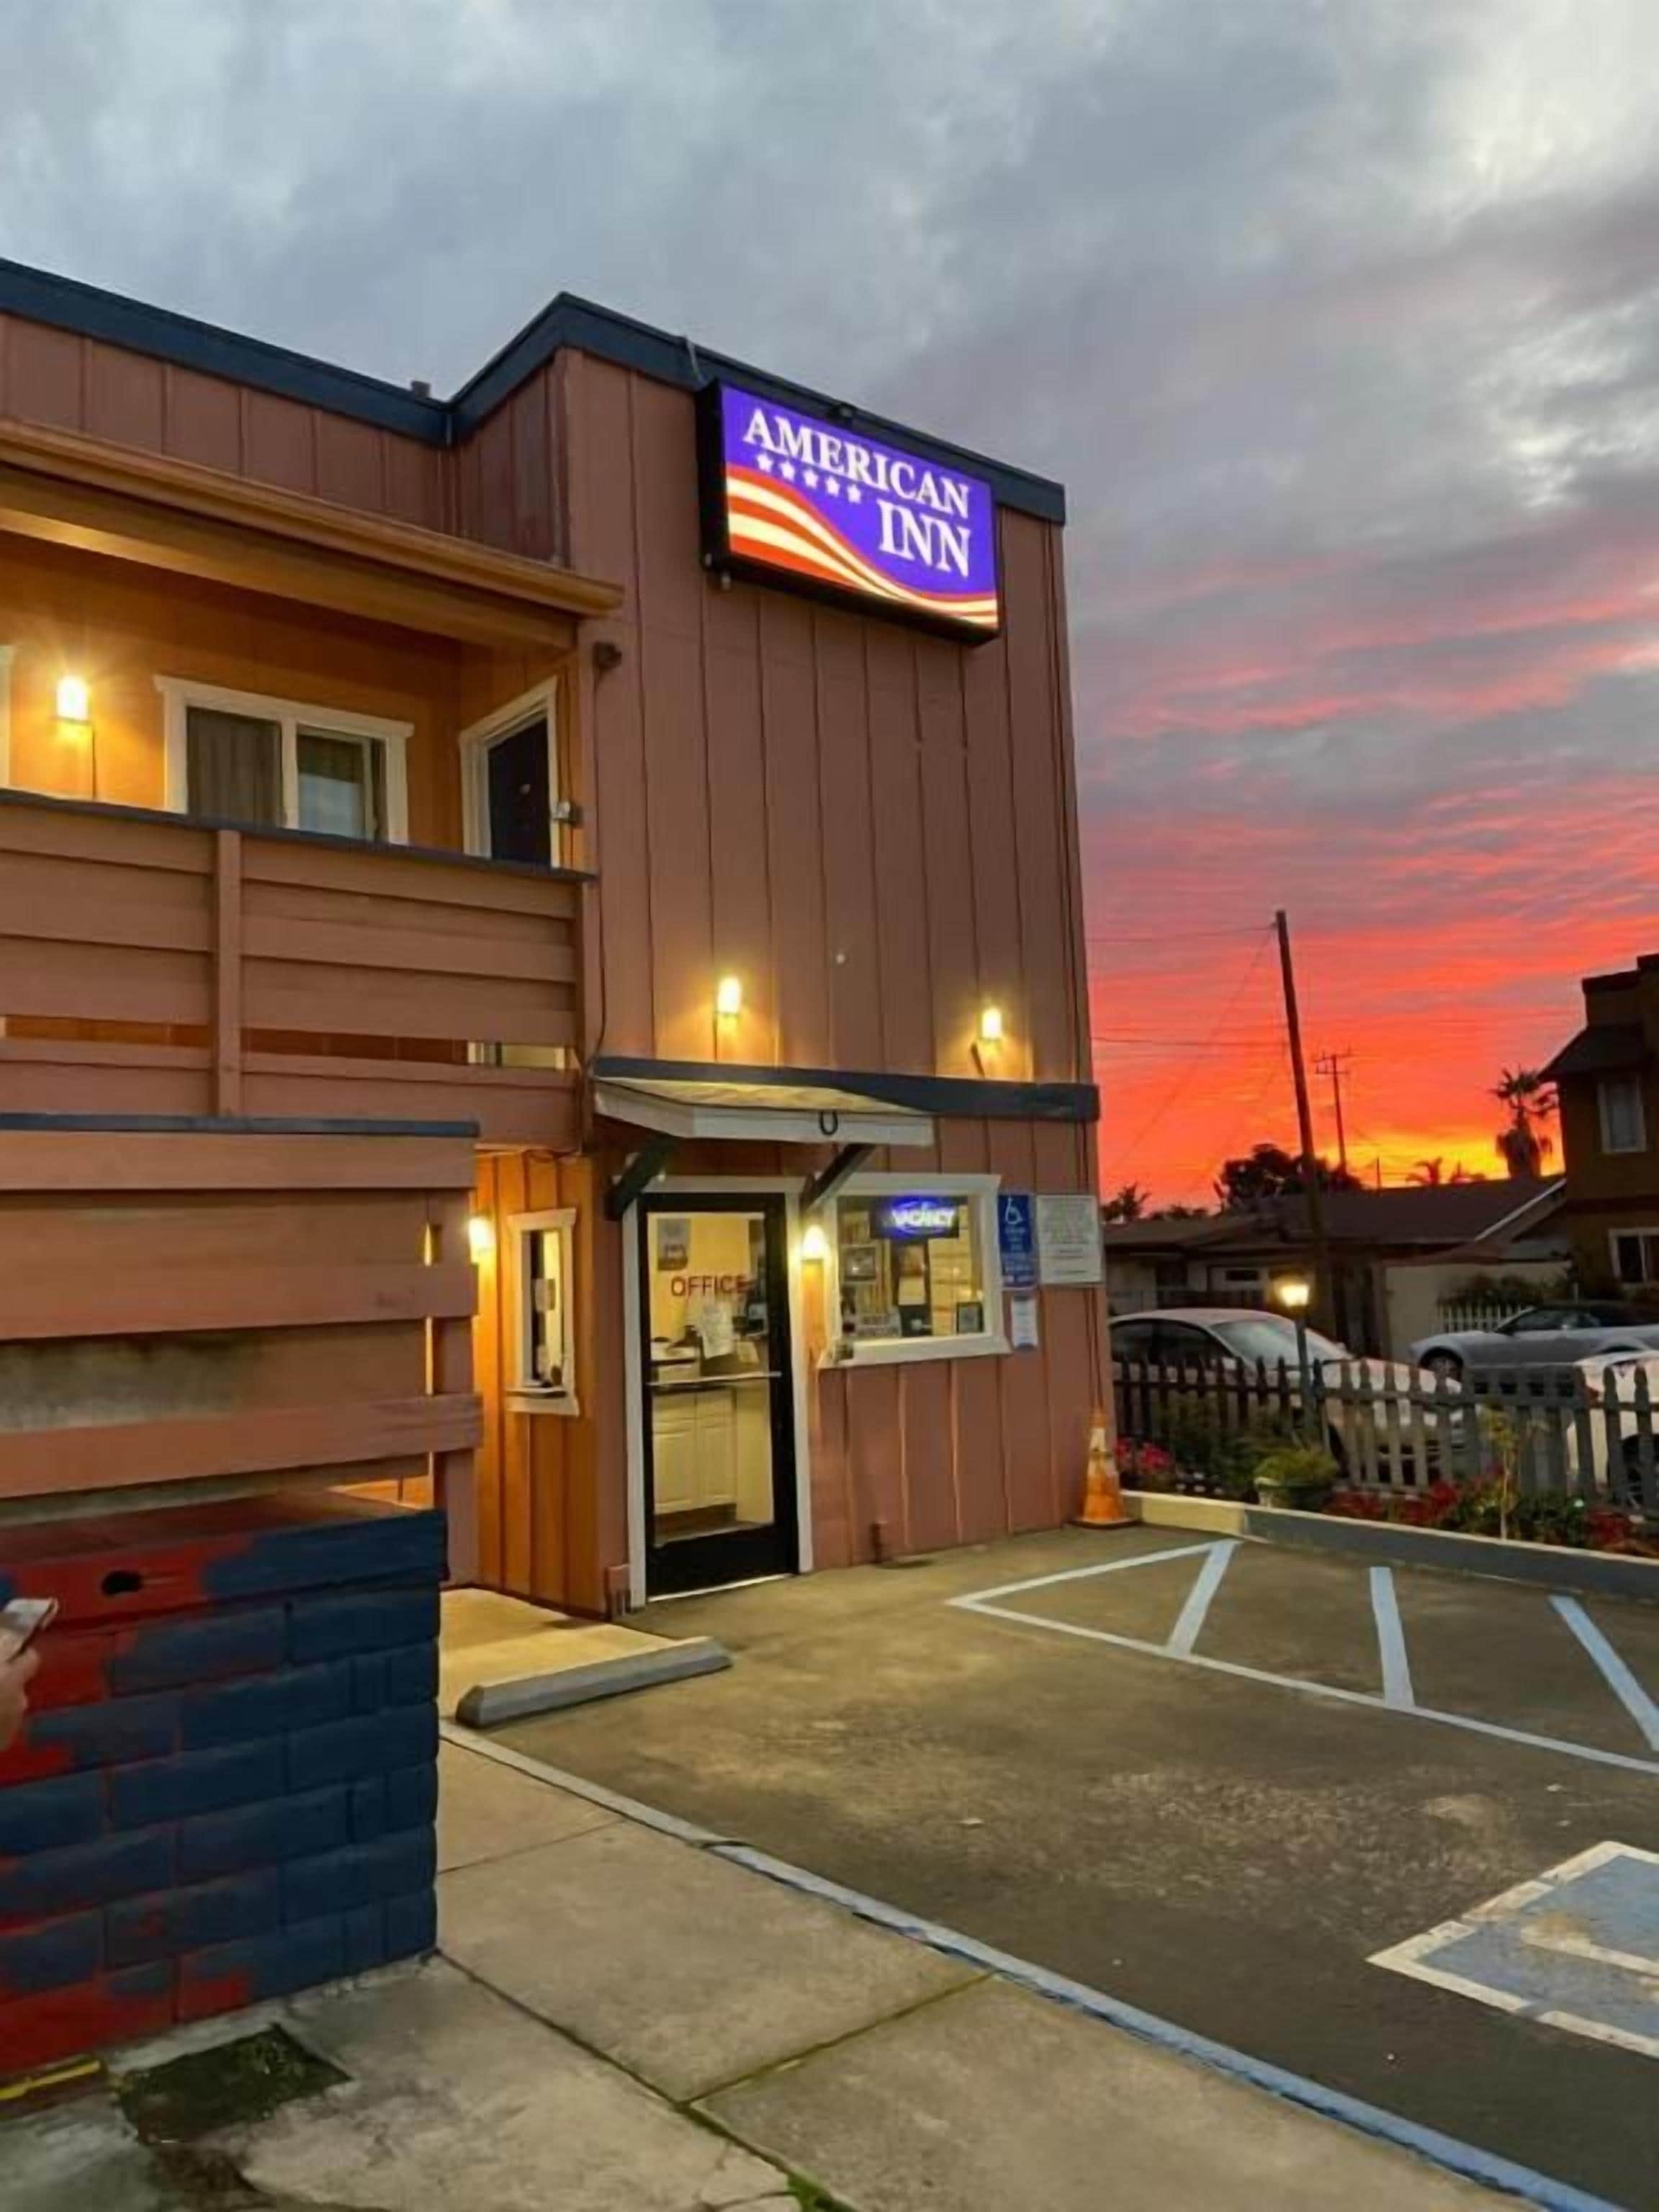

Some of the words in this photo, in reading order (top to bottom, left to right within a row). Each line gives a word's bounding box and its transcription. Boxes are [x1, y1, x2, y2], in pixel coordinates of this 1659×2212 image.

[743, 408, 969, 518] AMERICAN
[877, 499, 971, 577] INN
[671, 1275, 749, 1298] OFFICE
